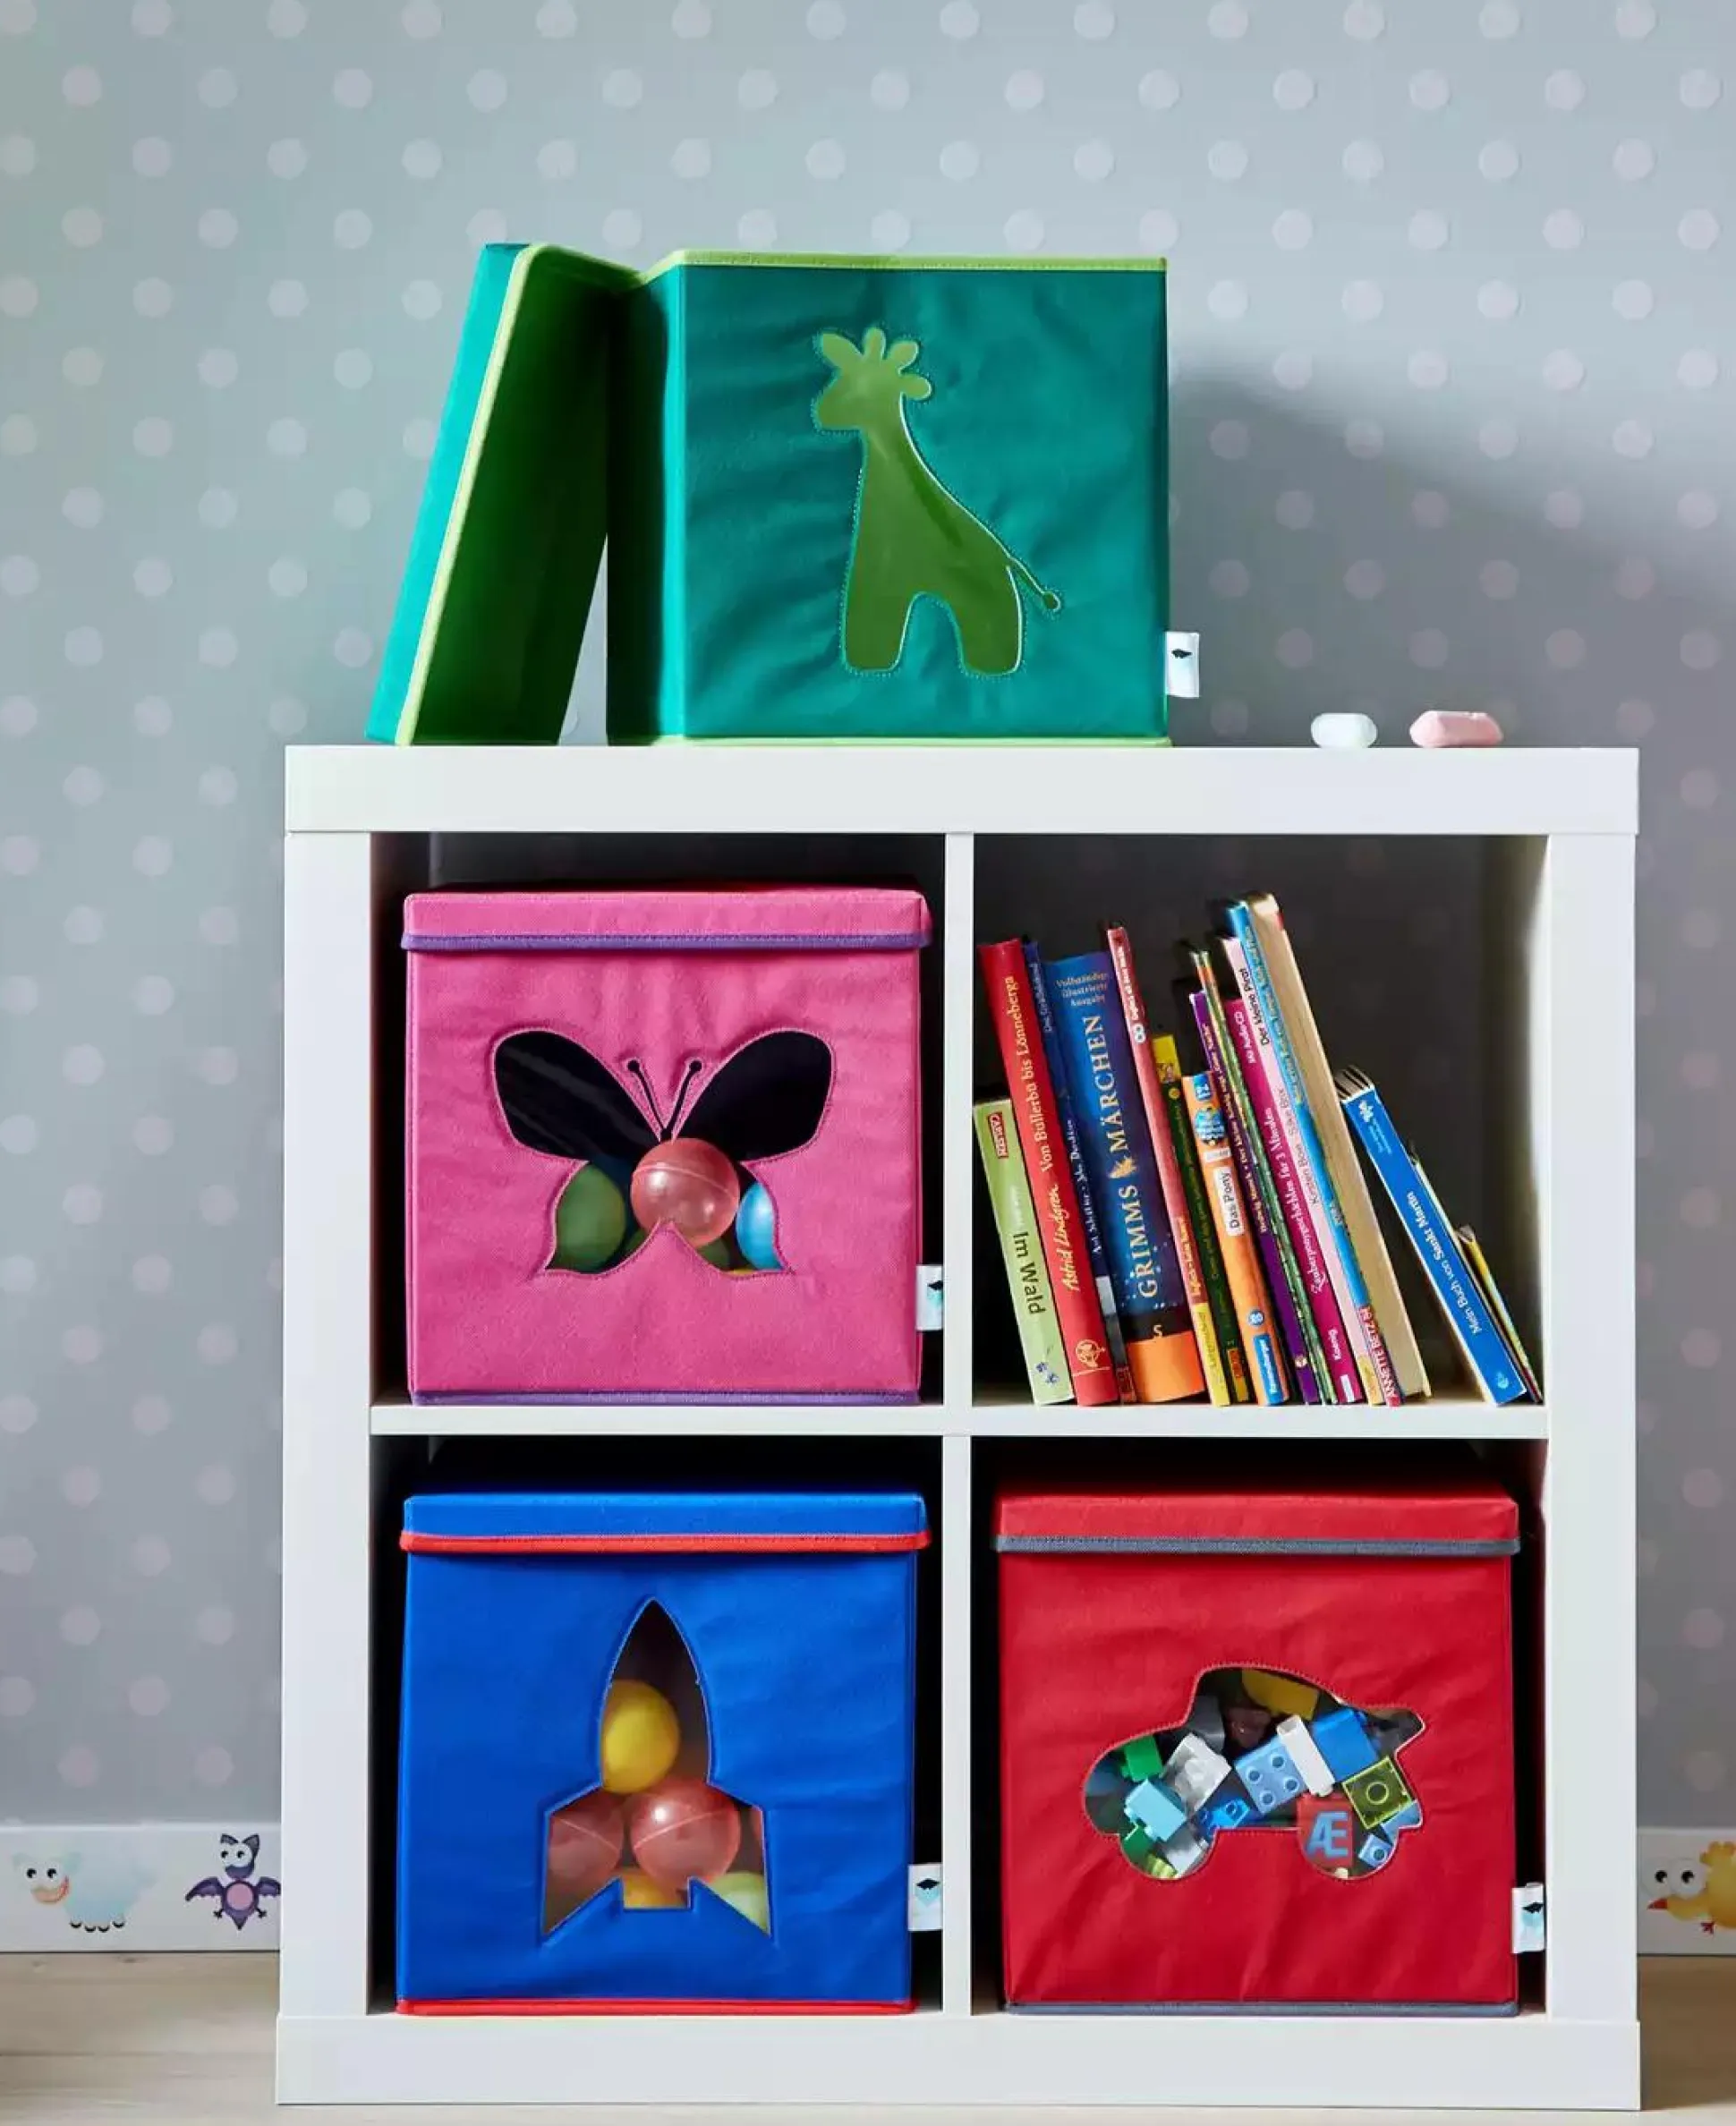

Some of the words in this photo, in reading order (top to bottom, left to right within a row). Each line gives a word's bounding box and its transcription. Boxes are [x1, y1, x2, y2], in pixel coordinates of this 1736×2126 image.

[1005, 976, 1029, 1057] Lönneberga
[1258, 1026, 1270, 1046] Der
[1022, 1059, 1035, 1082] bis
[1084, 1016, 1129, 1152] MÄRCHEN
[1025, 1083, 1048, 1143] Bullerbü
[1040, 1144, 1053, 1172] Von
[1221, 1171, 1235, 1204] Pony
[1049, 1184, 1070, 1245] Lindgren
[1228, 1207, 1240, 1229] Das
[1406, 1190, 1430, 1229] Martin
[1013, 1231, 1029, 1259] Im
[1119, 1184, 1158, 1297] GRIMMS
[1423, 1228, 1445, 1262] Sankt
[1059, 1247, 1080, 1291] Astrid
[1442, 1261, 1456, 1281] von
[1020, 1263, 1046, 1314] Wald
[1451, 1281, 1469, 1309] Buch
[1465, 1307, 1483, 1335] Mein
[1306, 1812, 1349, 1858] Æ
